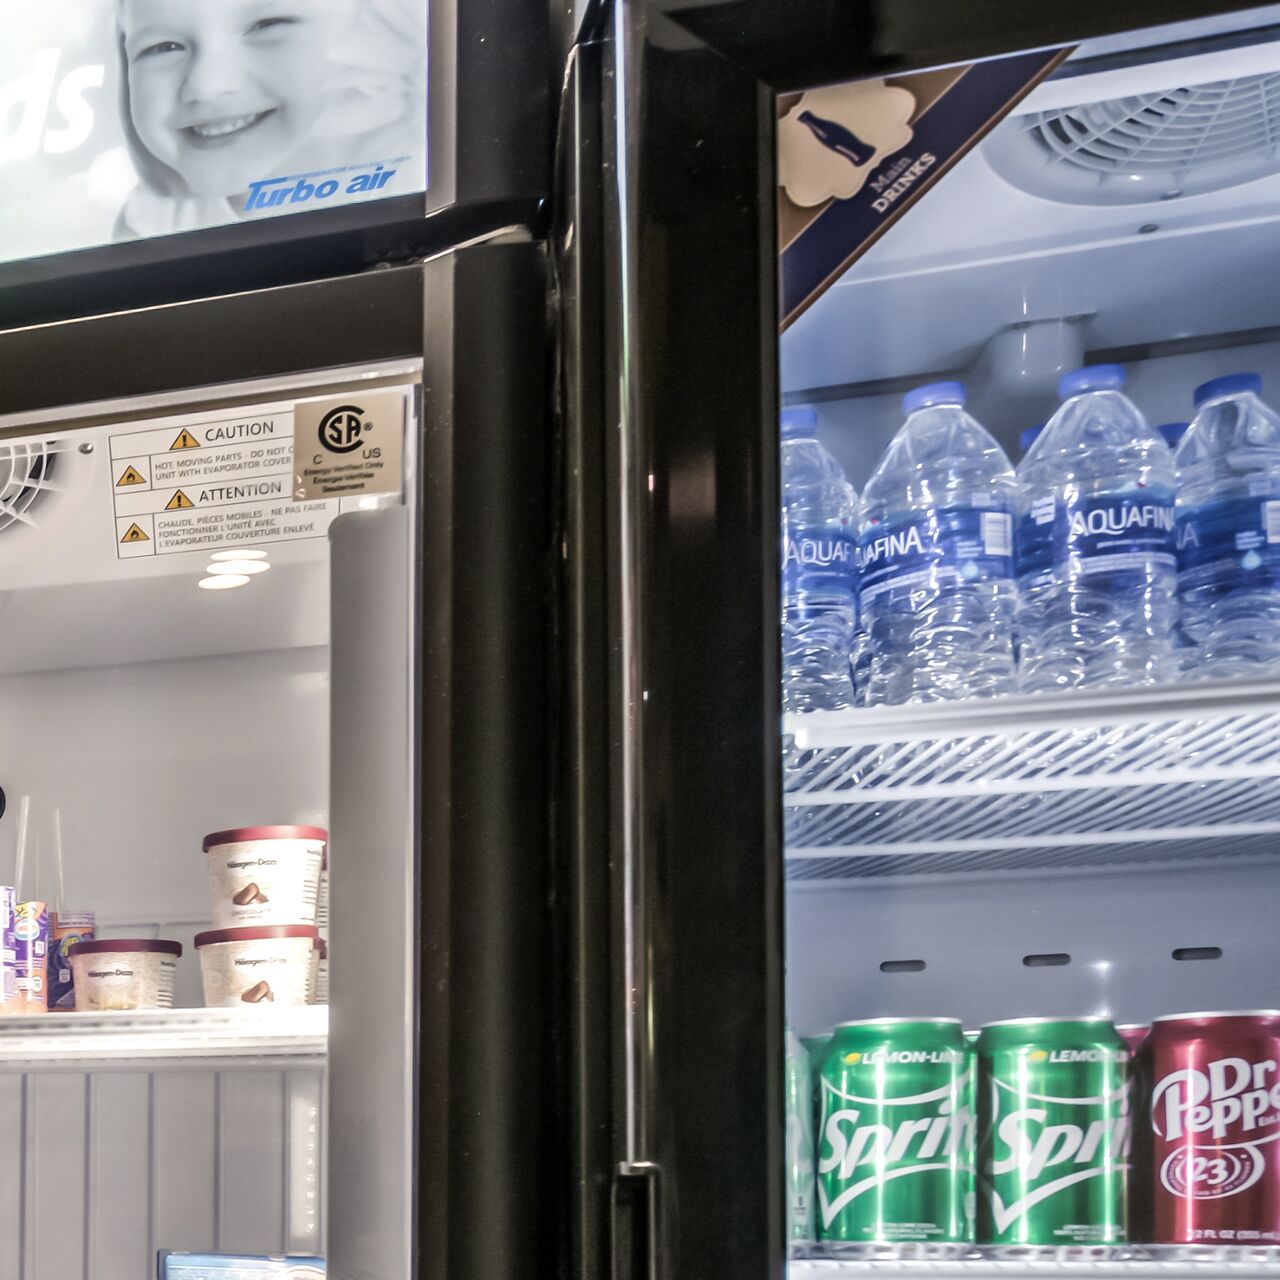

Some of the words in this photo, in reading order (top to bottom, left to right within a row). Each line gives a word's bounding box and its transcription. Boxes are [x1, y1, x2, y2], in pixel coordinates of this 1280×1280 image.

[243, 177, 339, 212] Turbo
[346, 166, 396, 193] air
[870, 156, 911, 193] Main
[872, 152, 935, 213] DRINKS
[205, 421, 274, 441] CAUTION
[176, 457, 213, 469] MOVING
[215, 453, 242, 464] PARTS
[250, 450, 264, 459] DO
[266, 447, 287, 457] NOT
[313, 454, 322, 465] C
[362, 448, 381, 460] US
[155, 471, 177, 481] UNIT
[178, 468, 201, 478] WITH
[199, 481, 282, 502] ATTENTION
[271, 507, 284, 516] NE
[284, 505, 301, 515] PAS
[1071, 506, 1174, 537] AQUAFIN
[1208, 1057, 1277, 1101] Dr
[1152, 1069, 1280, 1141] Peppe
[821, 1100, 978, 1180] Sprit
[993, 1098, 1130, 1180] Spri
[1189, 1156, 1229, 1186] 23
